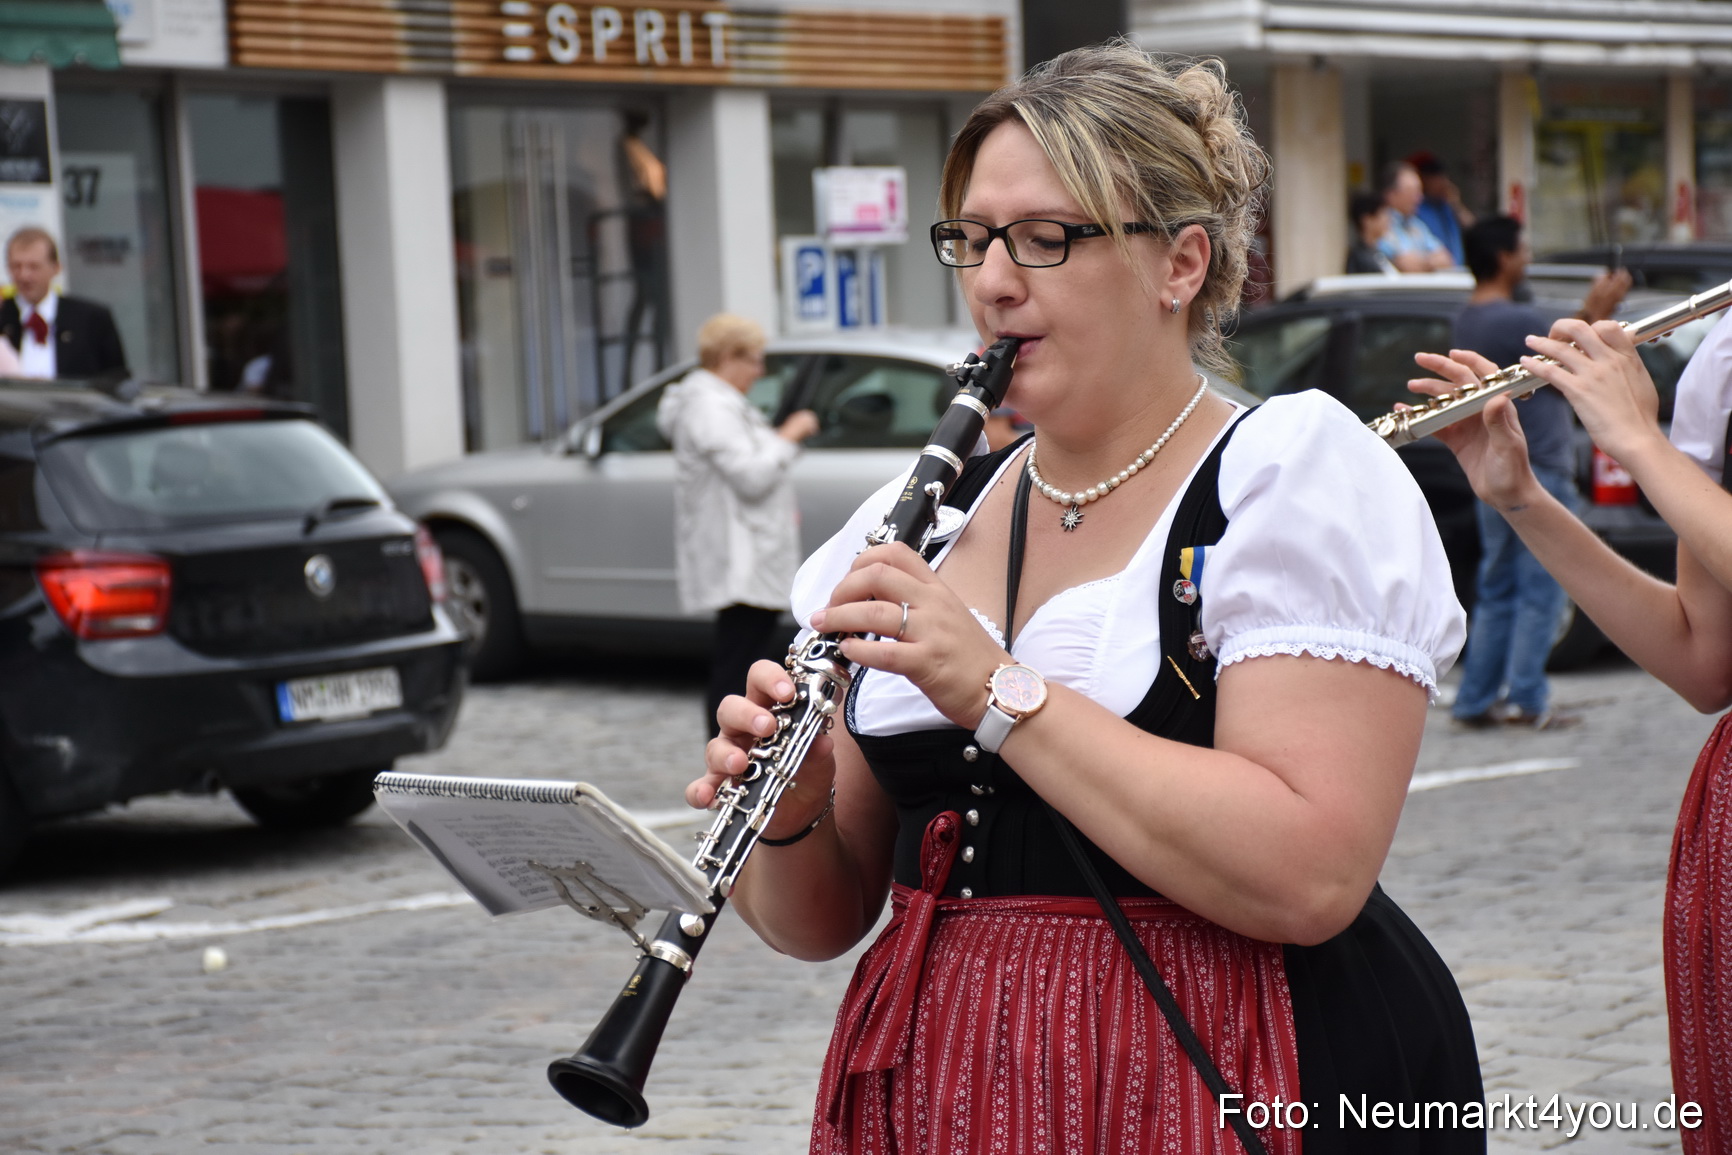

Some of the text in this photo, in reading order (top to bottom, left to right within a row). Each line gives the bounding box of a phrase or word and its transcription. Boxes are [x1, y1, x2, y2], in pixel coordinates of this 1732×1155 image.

[500, 1, 730, 67] ESPRIT
[64, 167, 100, 208] 37
[799, 250, 824, 294] P
